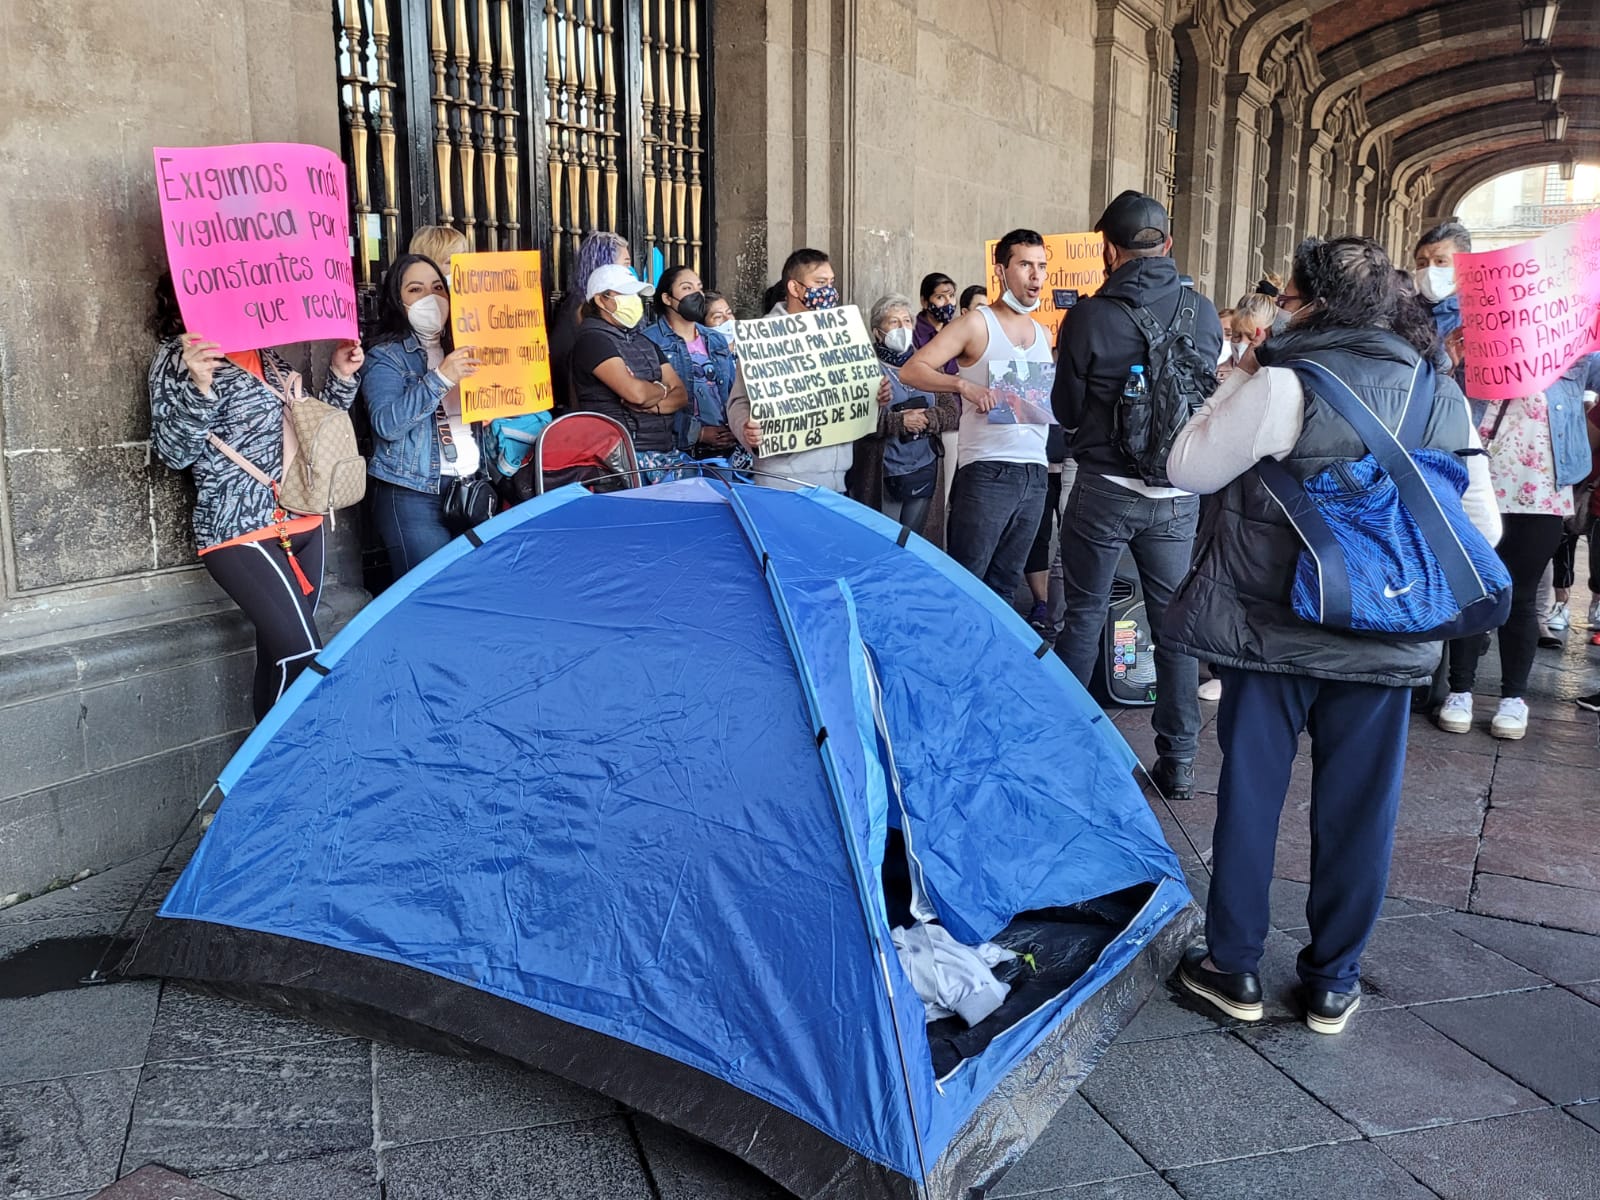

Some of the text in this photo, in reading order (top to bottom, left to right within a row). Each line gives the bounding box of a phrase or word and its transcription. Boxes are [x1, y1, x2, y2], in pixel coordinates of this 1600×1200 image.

[160, 157, 287, 201] Exigimos
[308, 210, 335, 240] por
[244, 296, 288, 330] que
[1480, 286, 1501, 307] del
[457, 307, 481, 333] del
[735, 309, 848, 341] EXIGIMOS MAS
[736, 330, 851, 361] VIGILANCIA POR LAS
[743, 343, 876, 380] CONSTANTES AMENAZAS
[746, 382, 764, 401] DE
[762, 381, 784, 398] LOS
[784, 372, 826, 395] GRUPOS
[827, 368, 849, 386] QUE
[851, 365, 864, 380] SE
[751, 383, 870, 420] CAN AMEDRENTAR A LOS
[760, 401, 869, 435] HABITANTES DE SAN
[805, 428, 822, 446] 68
